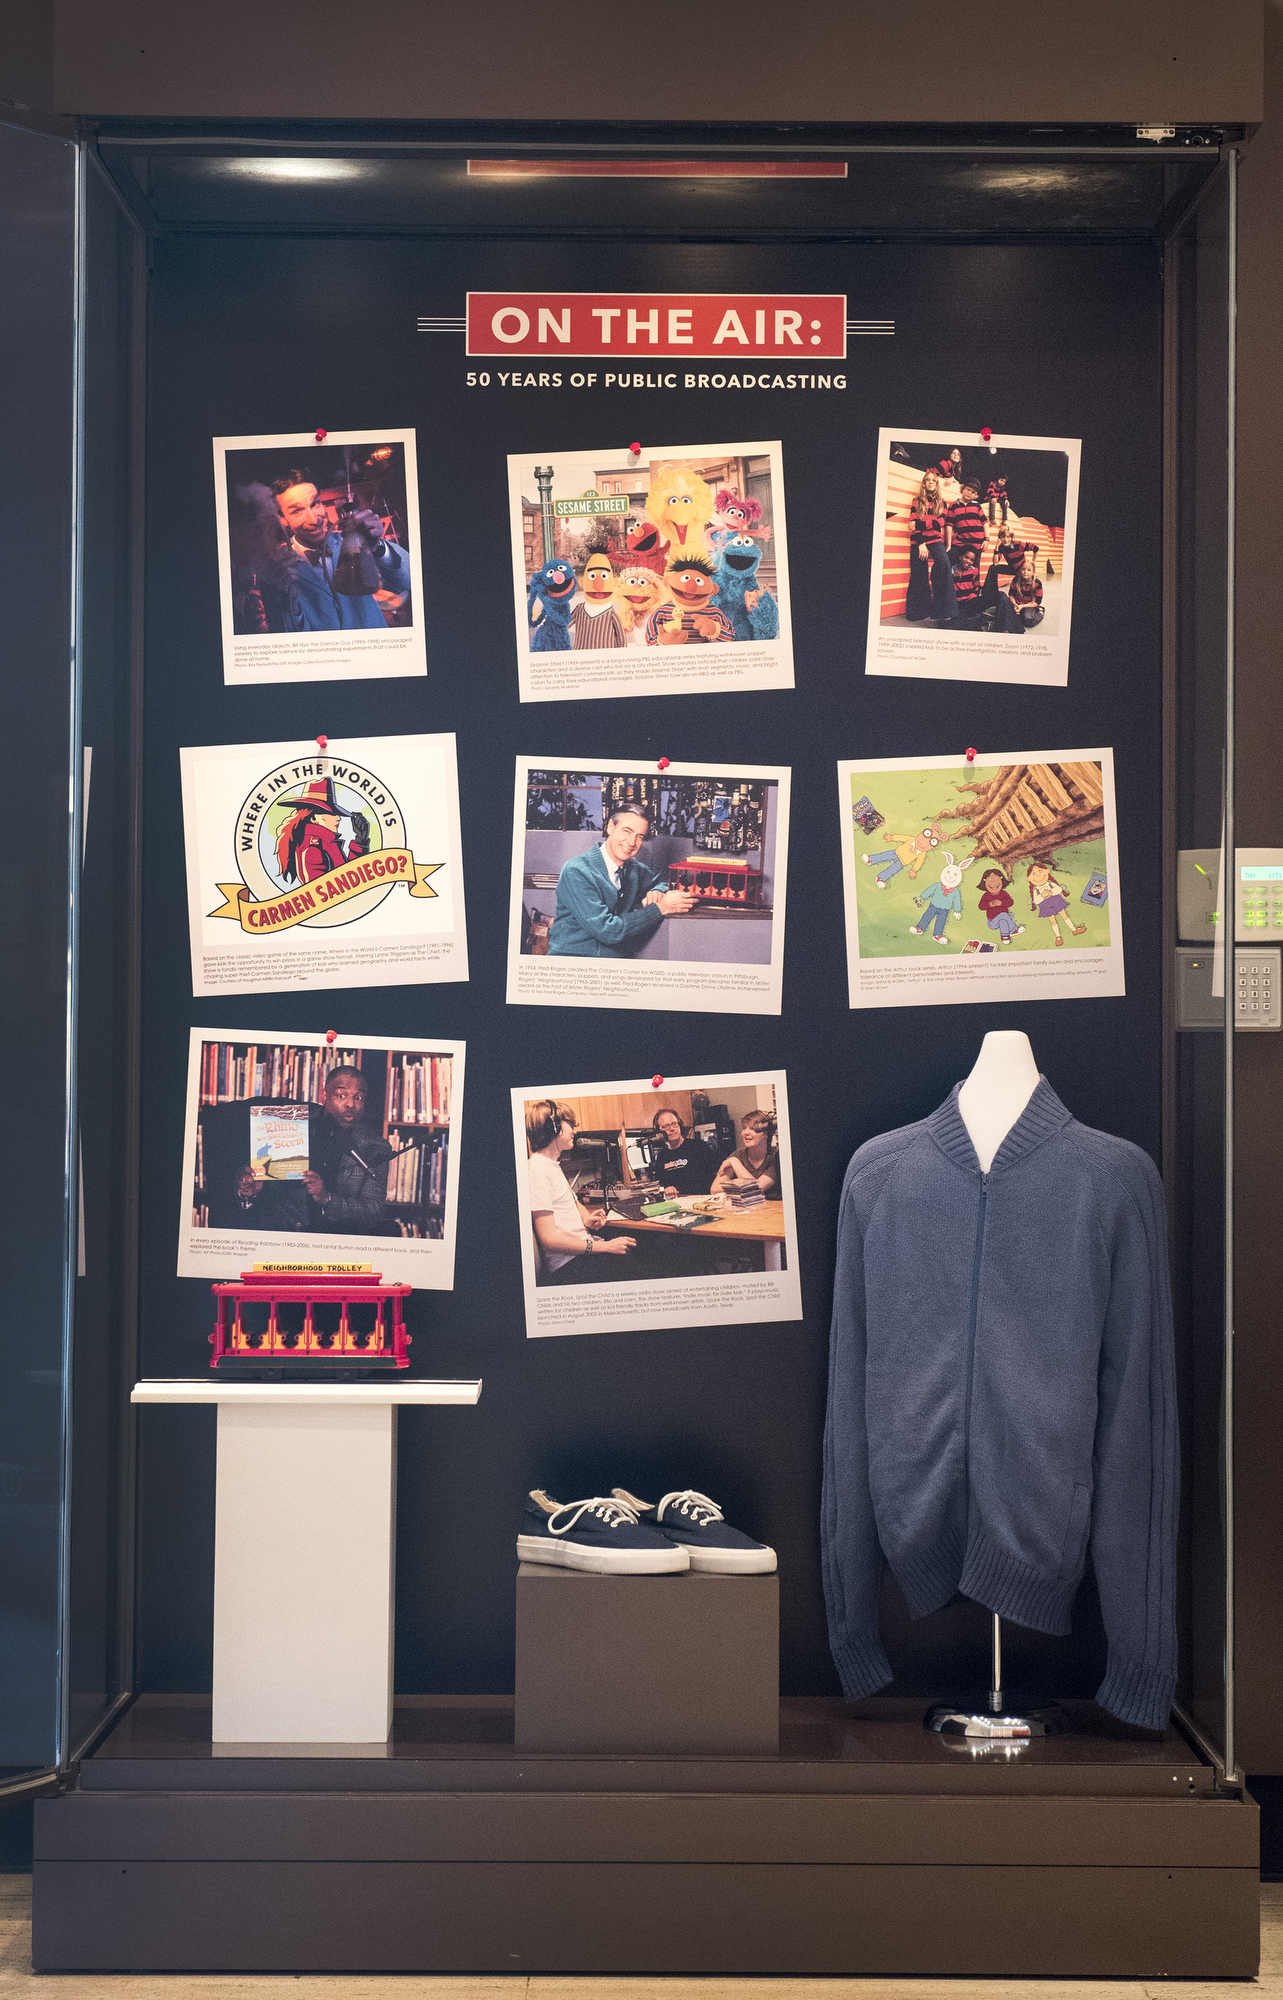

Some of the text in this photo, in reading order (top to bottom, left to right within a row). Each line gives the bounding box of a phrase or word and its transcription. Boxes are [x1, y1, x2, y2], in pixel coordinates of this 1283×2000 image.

[491, 306, 822, 346] ON THE AIR:
[466, 372, 847, 390] 50 YEARS OF PUBLIC BROADCASTING
[558, 498, 626, 514] SESAME STREET
[242, 764, 397, 852] WHERE IN THE WORLD IS
[248, 855, 408, 928] CARMEN SANDIEGO?
